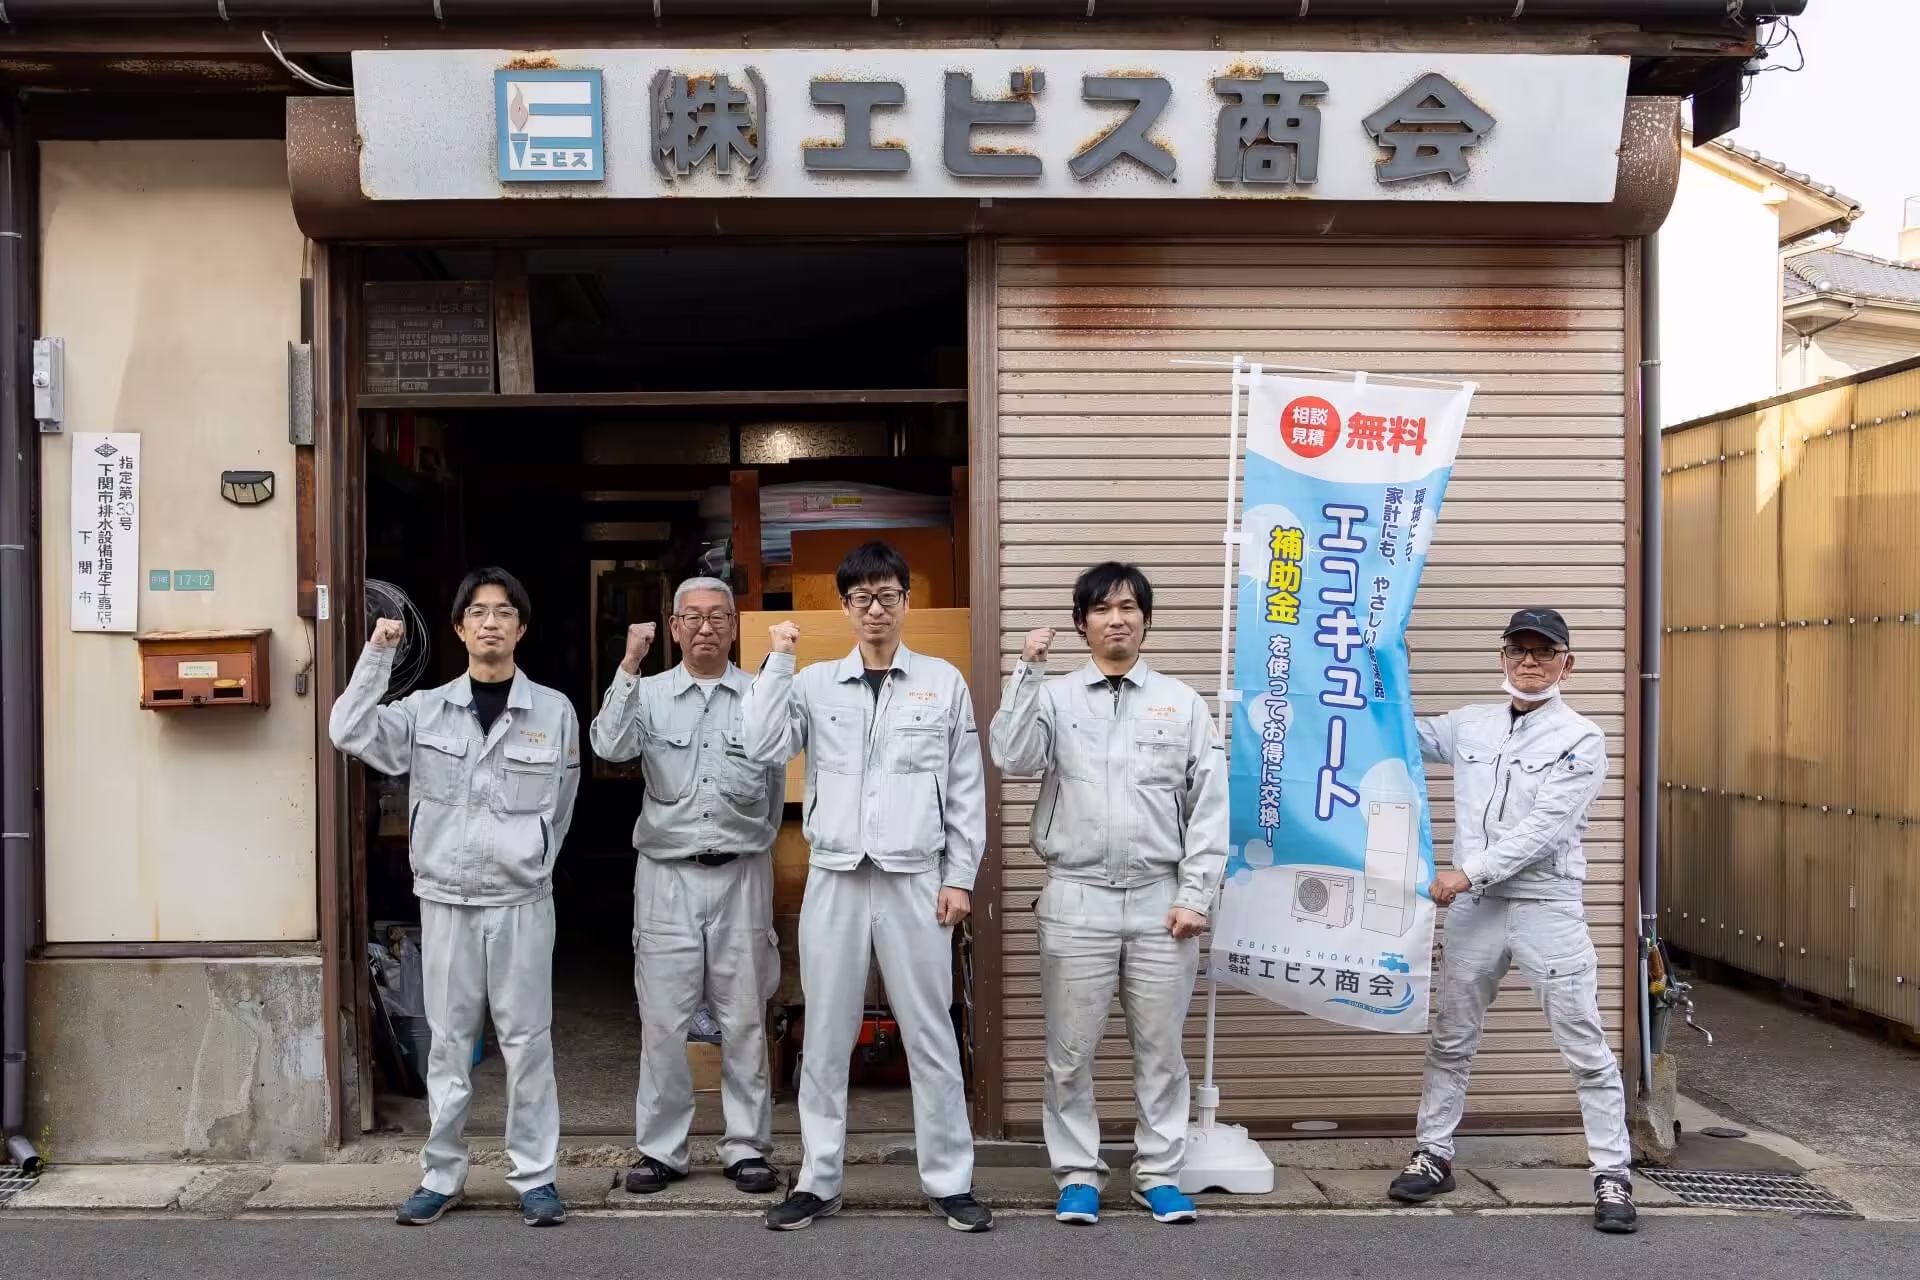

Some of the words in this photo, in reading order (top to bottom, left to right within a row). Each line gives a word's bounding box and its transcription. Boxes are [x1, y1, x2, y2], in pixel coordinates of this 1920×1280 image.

[530, 152, 588, 168] エビス
[1291, 405, 1329, 427] 相談
[1291, 427, 1326, 447] 見積
[1346, 412, 1427, 456] 無料
[1265, 526, 1305, 626] 補助金
[1314, 503, 1369, 820] エコキュート
[1228, 952, 1250, 965] 株式
[1236, 939, 1291, 955] EBISU
[1305, 950, 1375, 967] SHOKAI
[1228, 964, 1250, 977] 会社
[1257, 958, 1396, 998] エビス商会
